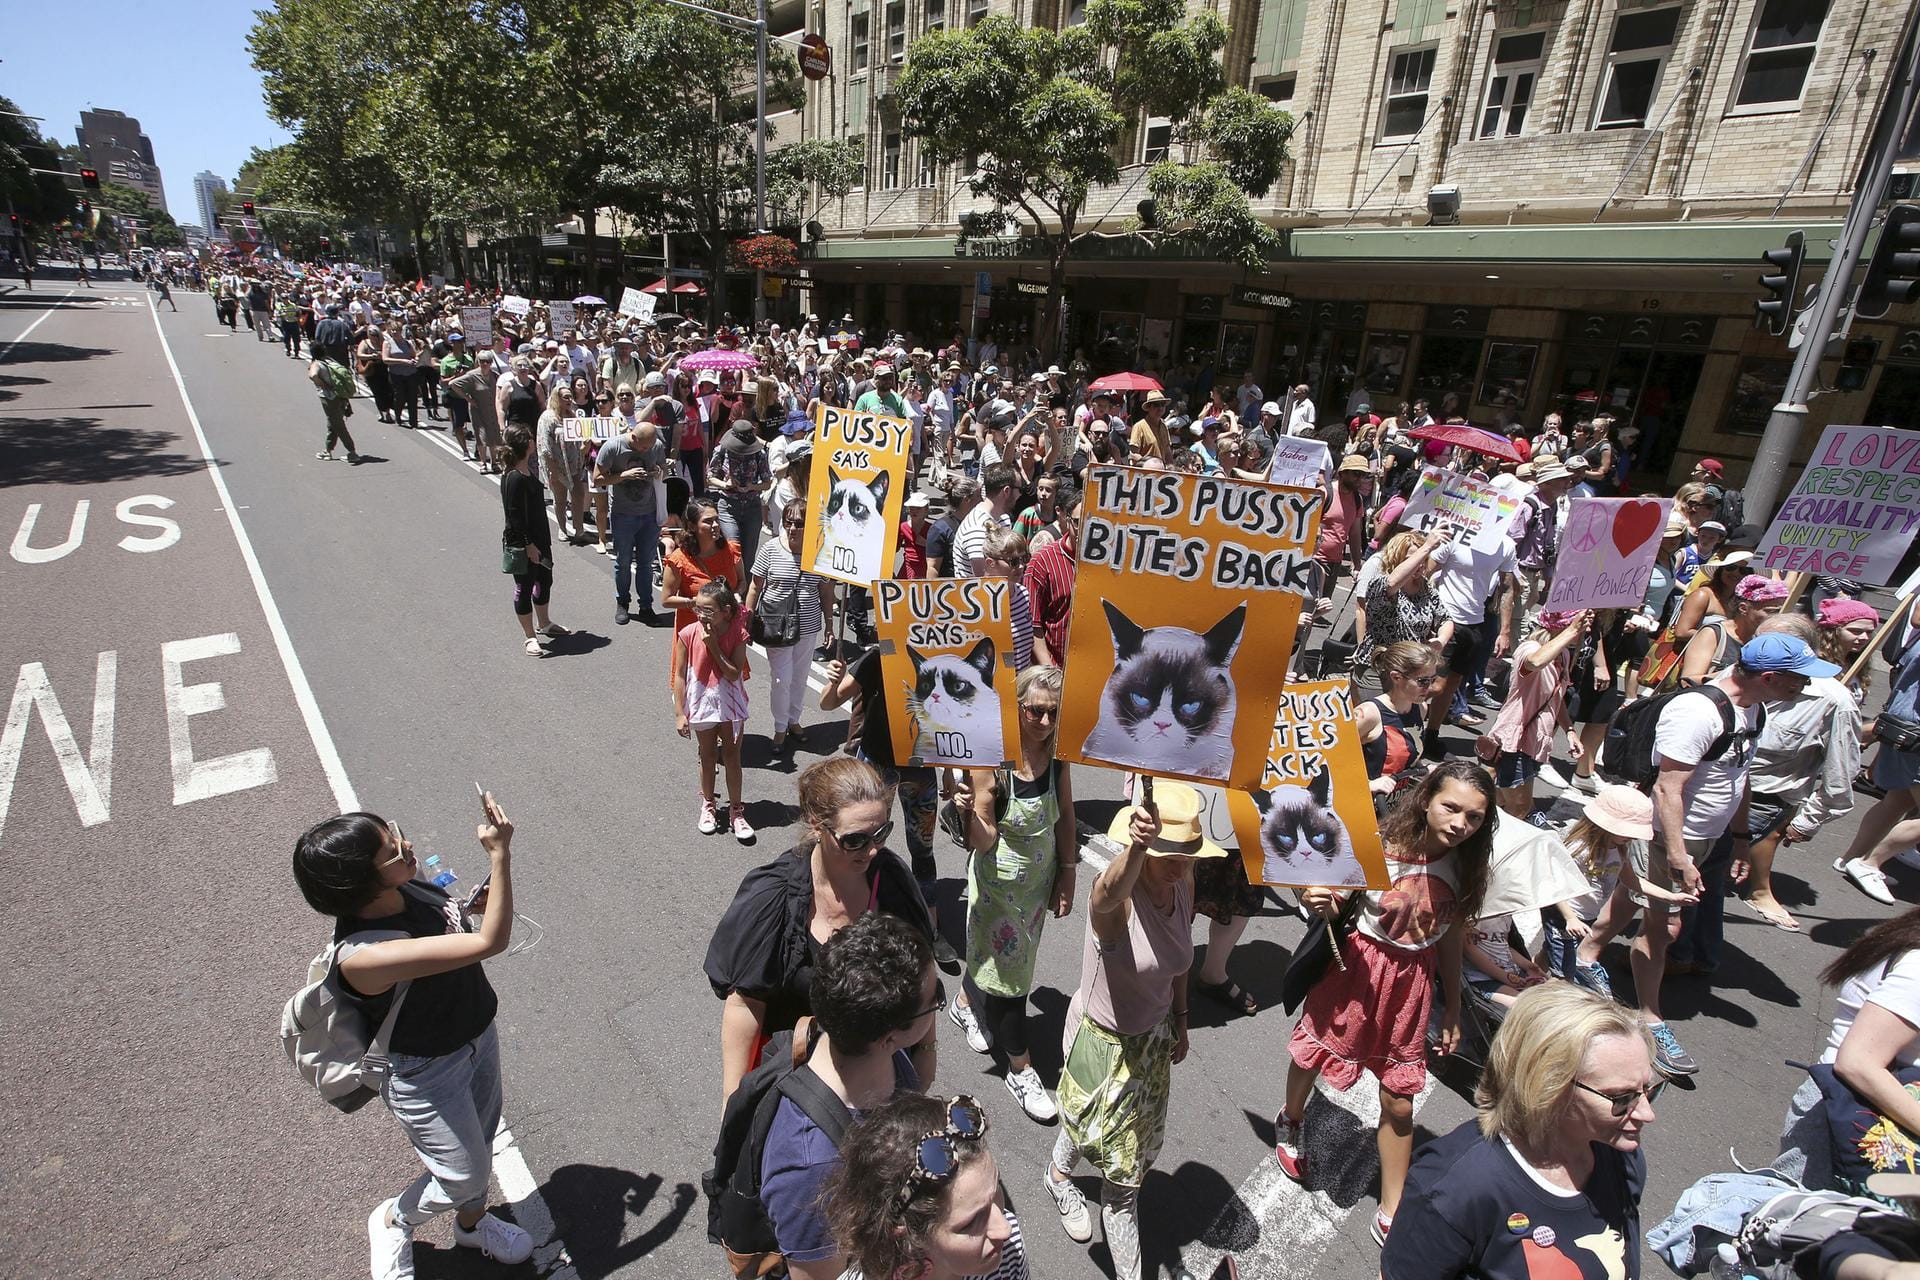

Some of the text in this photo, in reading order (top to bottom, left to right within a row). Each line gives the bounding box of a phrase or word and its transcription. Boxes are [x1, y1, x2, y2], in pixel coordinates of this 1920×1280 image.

[790, 279, 814, 288] LOUNGE
[1243, 291, 1292, 307] ACCOMMODATION
[1641, 299, 1660, 309] 19
[565, 419, 619, 439] EQUALITY
[822, 409, 908, 453] PUSSY
[1279, 445, 1309, 462] babes
[1821, 432, 1920, 475] LOVE
[1442, 475, 1498, 509] LOVE
[1797, 466, 1920, 504] RESPEC
[1094, 469, 1321, 541] THIS PUSSY
[1434, 508, 1483, 531] TRUMPS
[1776, 497, 1920, 534] EQUALITY
[1420, 514, 1478, 547] HTE
[1779, 524, 1871, 551] UNITY
[832, 546, 858, 575] NO.
[1083, 522, 1314, 591] BITES BACK
[1765, 545, 1870, 577] PEACE
[1552, 565, 1647, 603] GIRL POWER
[880, 581, 1007, 620] PUSSY
[935, 731, 973, 759] NO.
[1264, 754, 1322, 781] ACK
